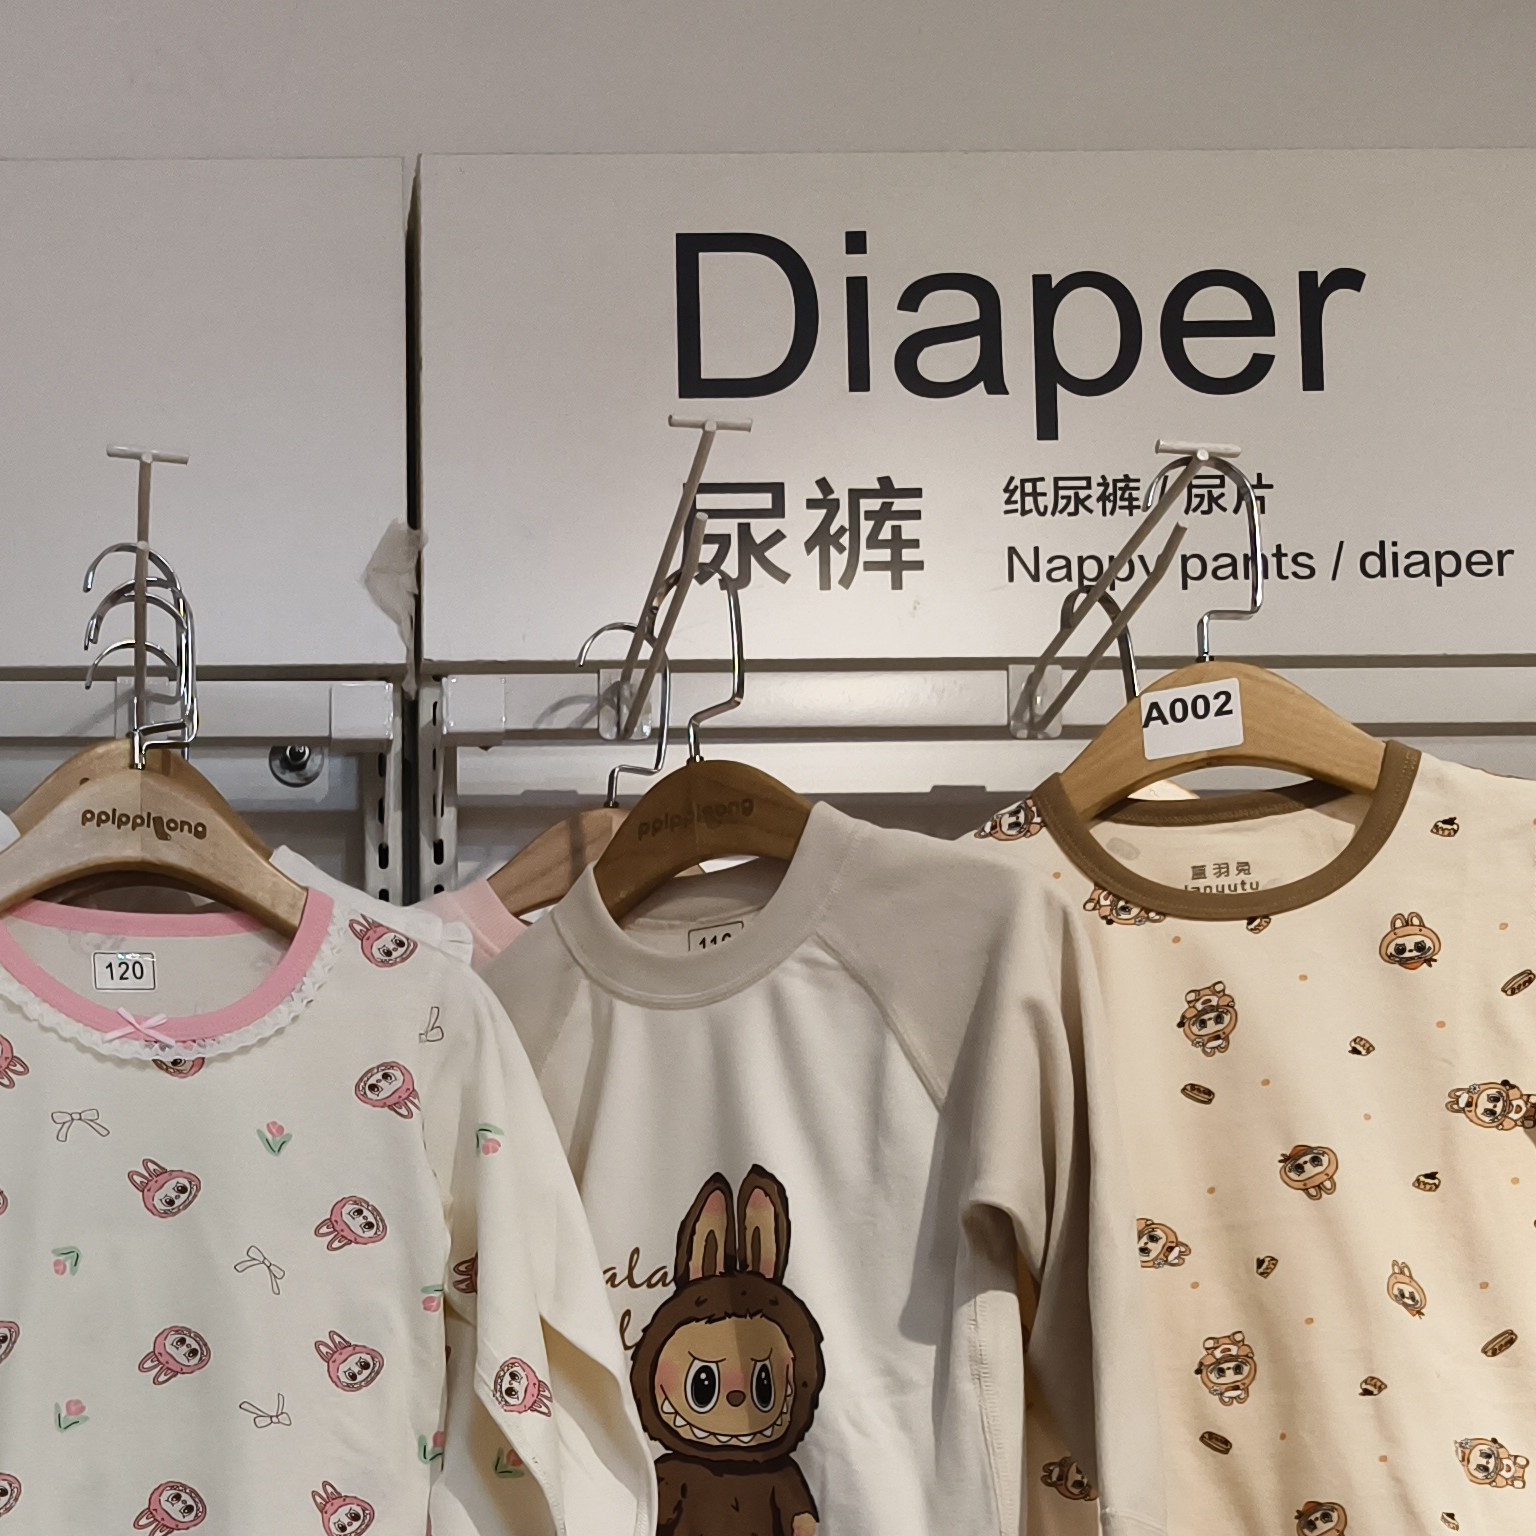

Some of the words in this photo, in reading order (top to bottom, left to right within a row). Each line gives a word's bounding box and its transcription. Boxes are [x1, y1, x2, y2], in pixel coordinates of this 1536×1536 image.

[675, 231, 1366, 441] Diaper
[1003, 474, 1142, 517] 纸尿裤
[1183, 473, 1274, 515] 尿片
[681, 476, 925, 591] 尿裤
[1180, 543, 1316, 590] pants
[1360, 539, 1515, 587] diaper
[1142, 690, 1233, 729] A002
[105, 960, 144, 981] 120
